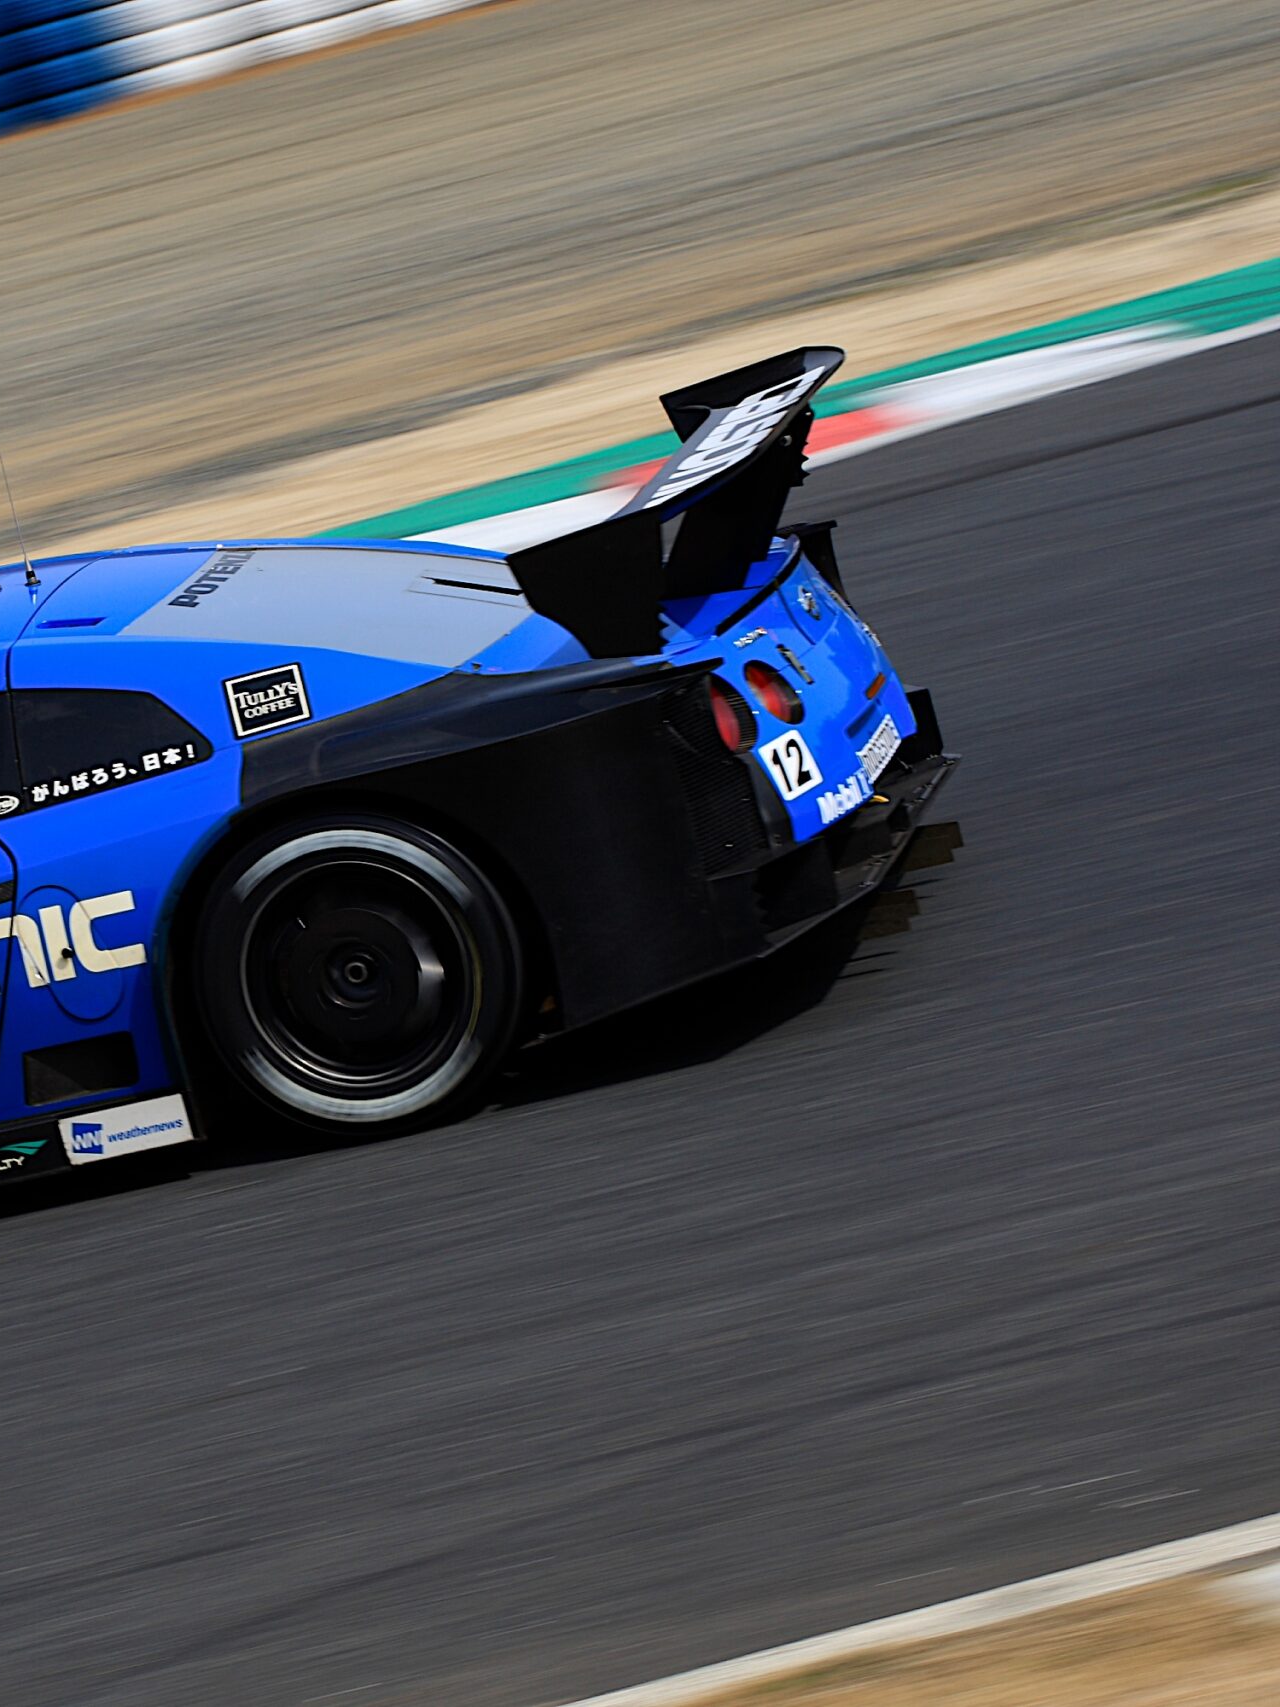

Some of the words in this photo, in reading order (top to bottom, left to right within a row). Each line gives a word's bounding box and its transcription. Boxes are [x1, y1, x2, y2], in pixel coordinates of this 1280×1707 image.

[244, 697, 297, 718] COFFEE
[772, 738, 813, 792] 12
[106, 1119, 184, 1143] weathernews
